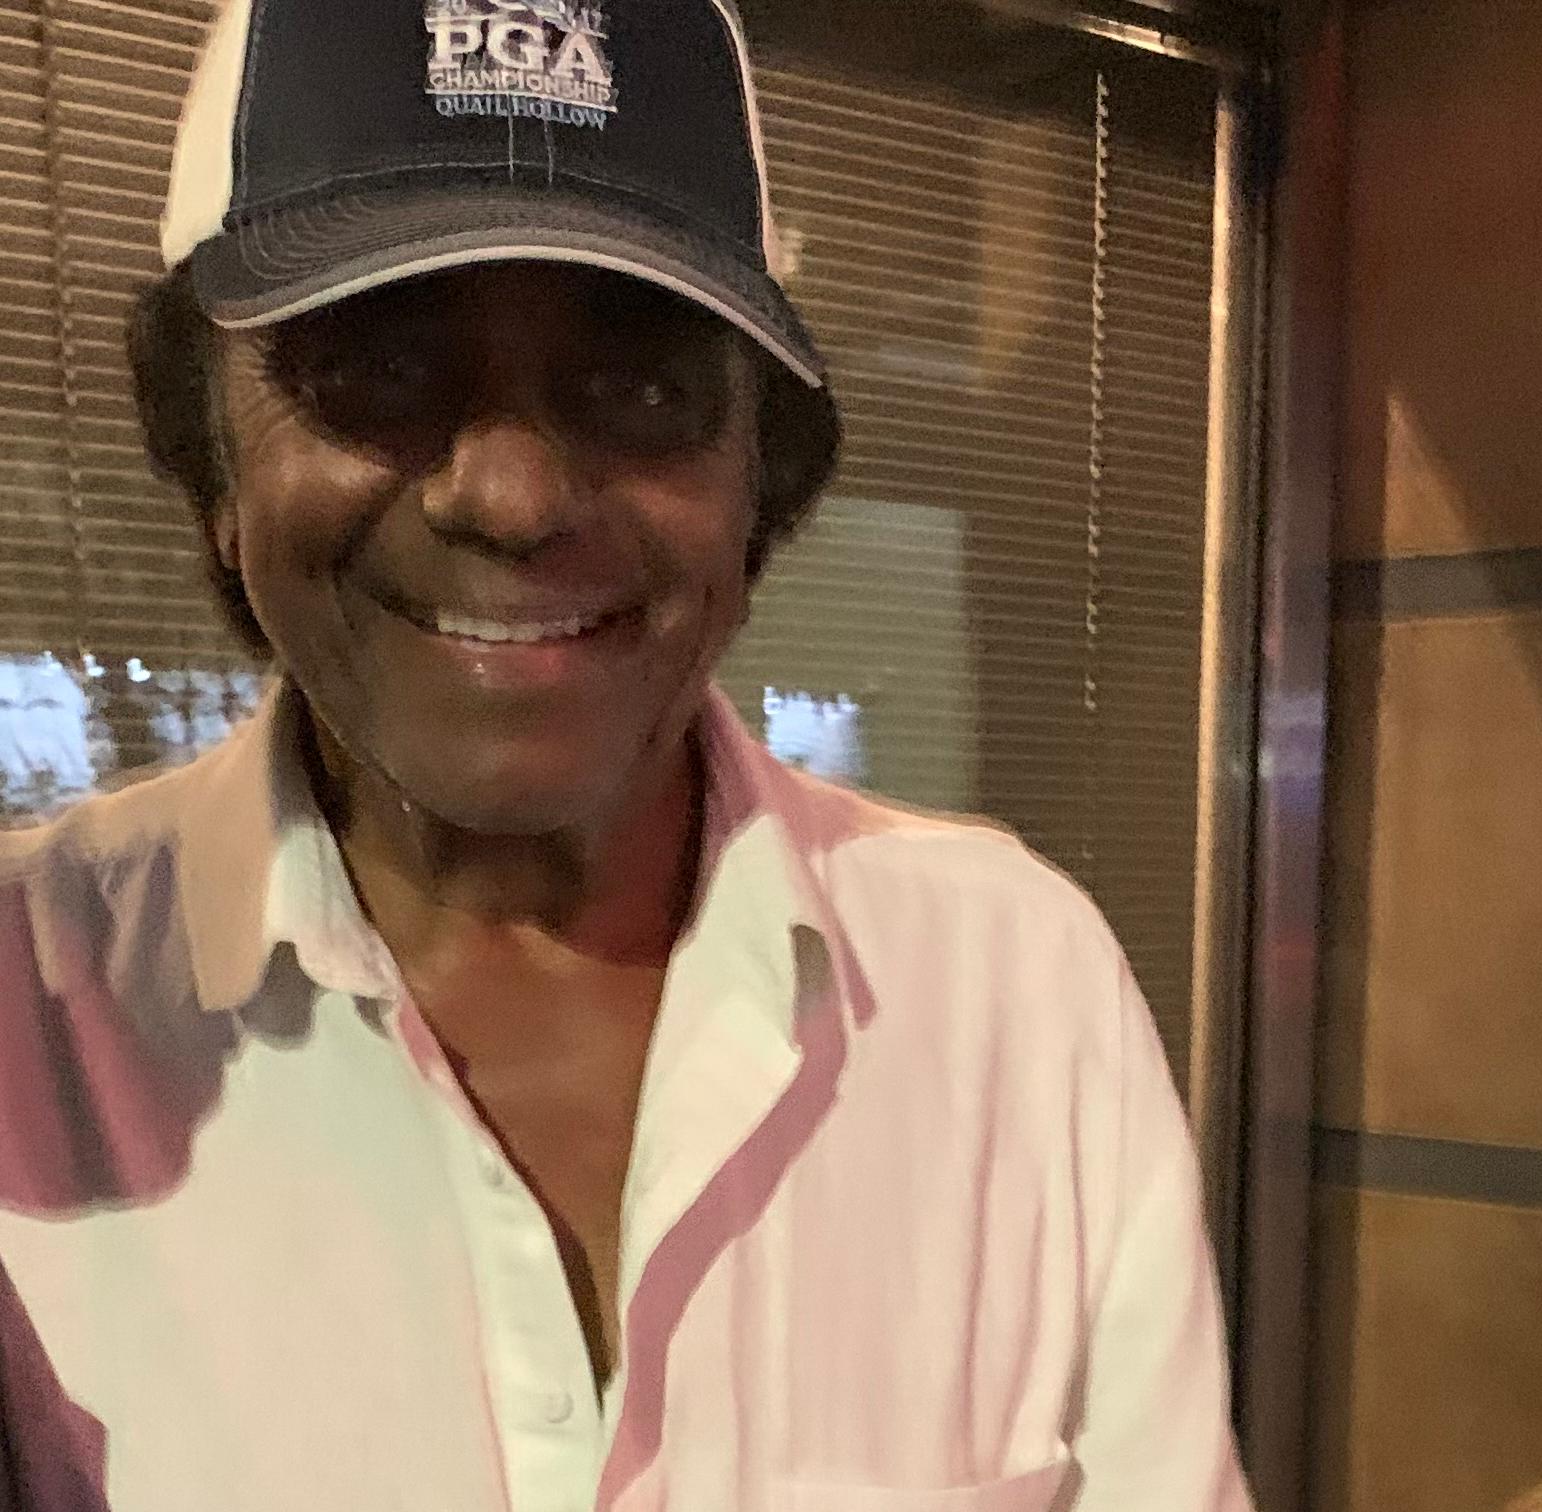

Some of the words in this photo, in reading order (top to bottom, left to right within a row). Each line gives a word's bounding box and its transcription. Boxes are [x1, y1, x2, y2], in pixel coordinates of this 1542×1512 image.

[425, 20, 613, 86] PGA
[429, 69, 611, 104] CHAMPIONSHIP
[436, 95, 509, 119] QUAIL
[512, 96, 607, 131] HOLLOW
